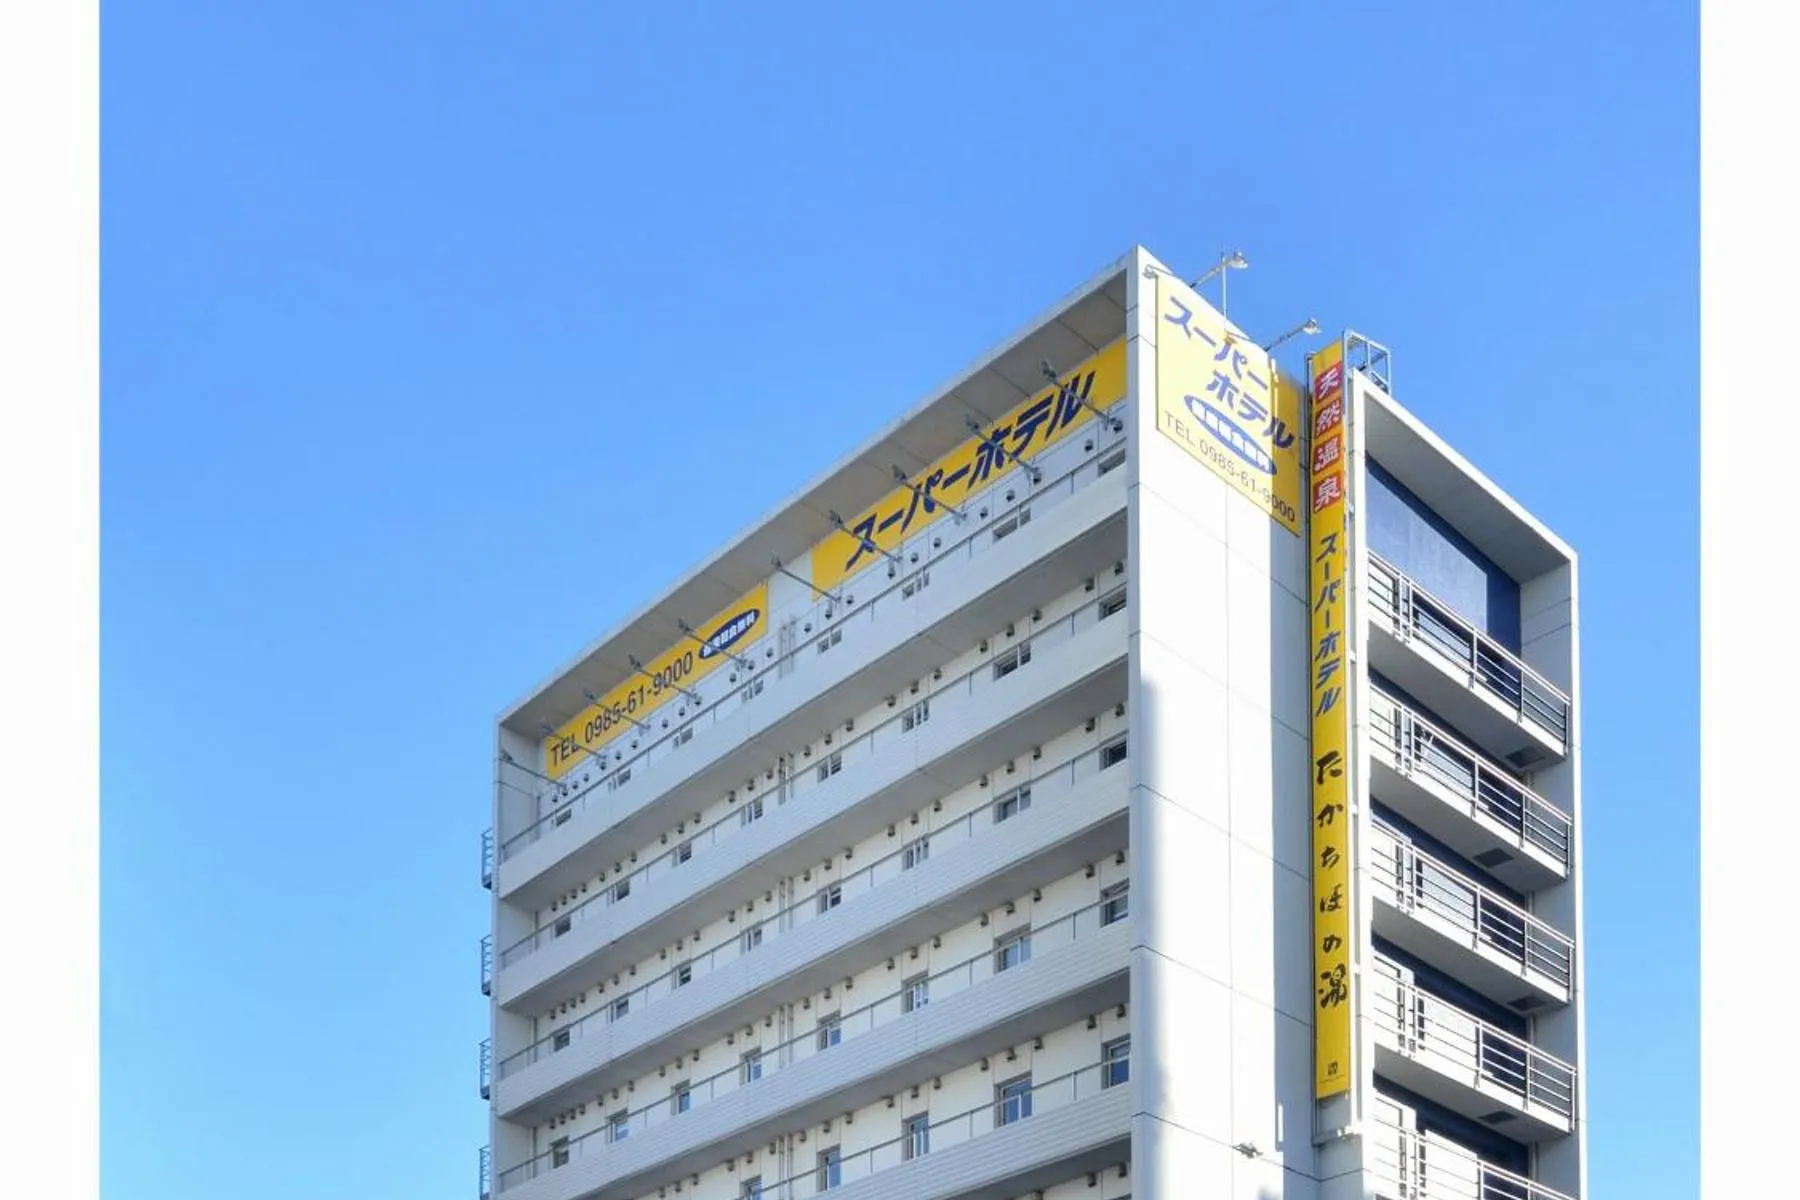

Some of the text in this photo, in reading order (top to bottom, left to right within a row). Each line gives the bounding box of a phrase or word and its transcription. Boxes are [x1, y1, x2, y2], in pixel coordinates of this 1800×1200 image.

[1164, 295, 1268, 392] スーパー
[844, 370, 1096, 572] スーパーホテル
[1164, 411, 1196, 444] TEL
[1199, 438, 1296, 523] 0985-61-9000
[1206, 369, 1295, 449] ホテル
[1314, 369, 1340, 508] 天然温泉
[1314, 532, 1342, 718] スーパーホテル
[550, 651, 693, 767] TEL 0985-61-9000
[1316, 749, 1348, 1009] たかちほの湯
